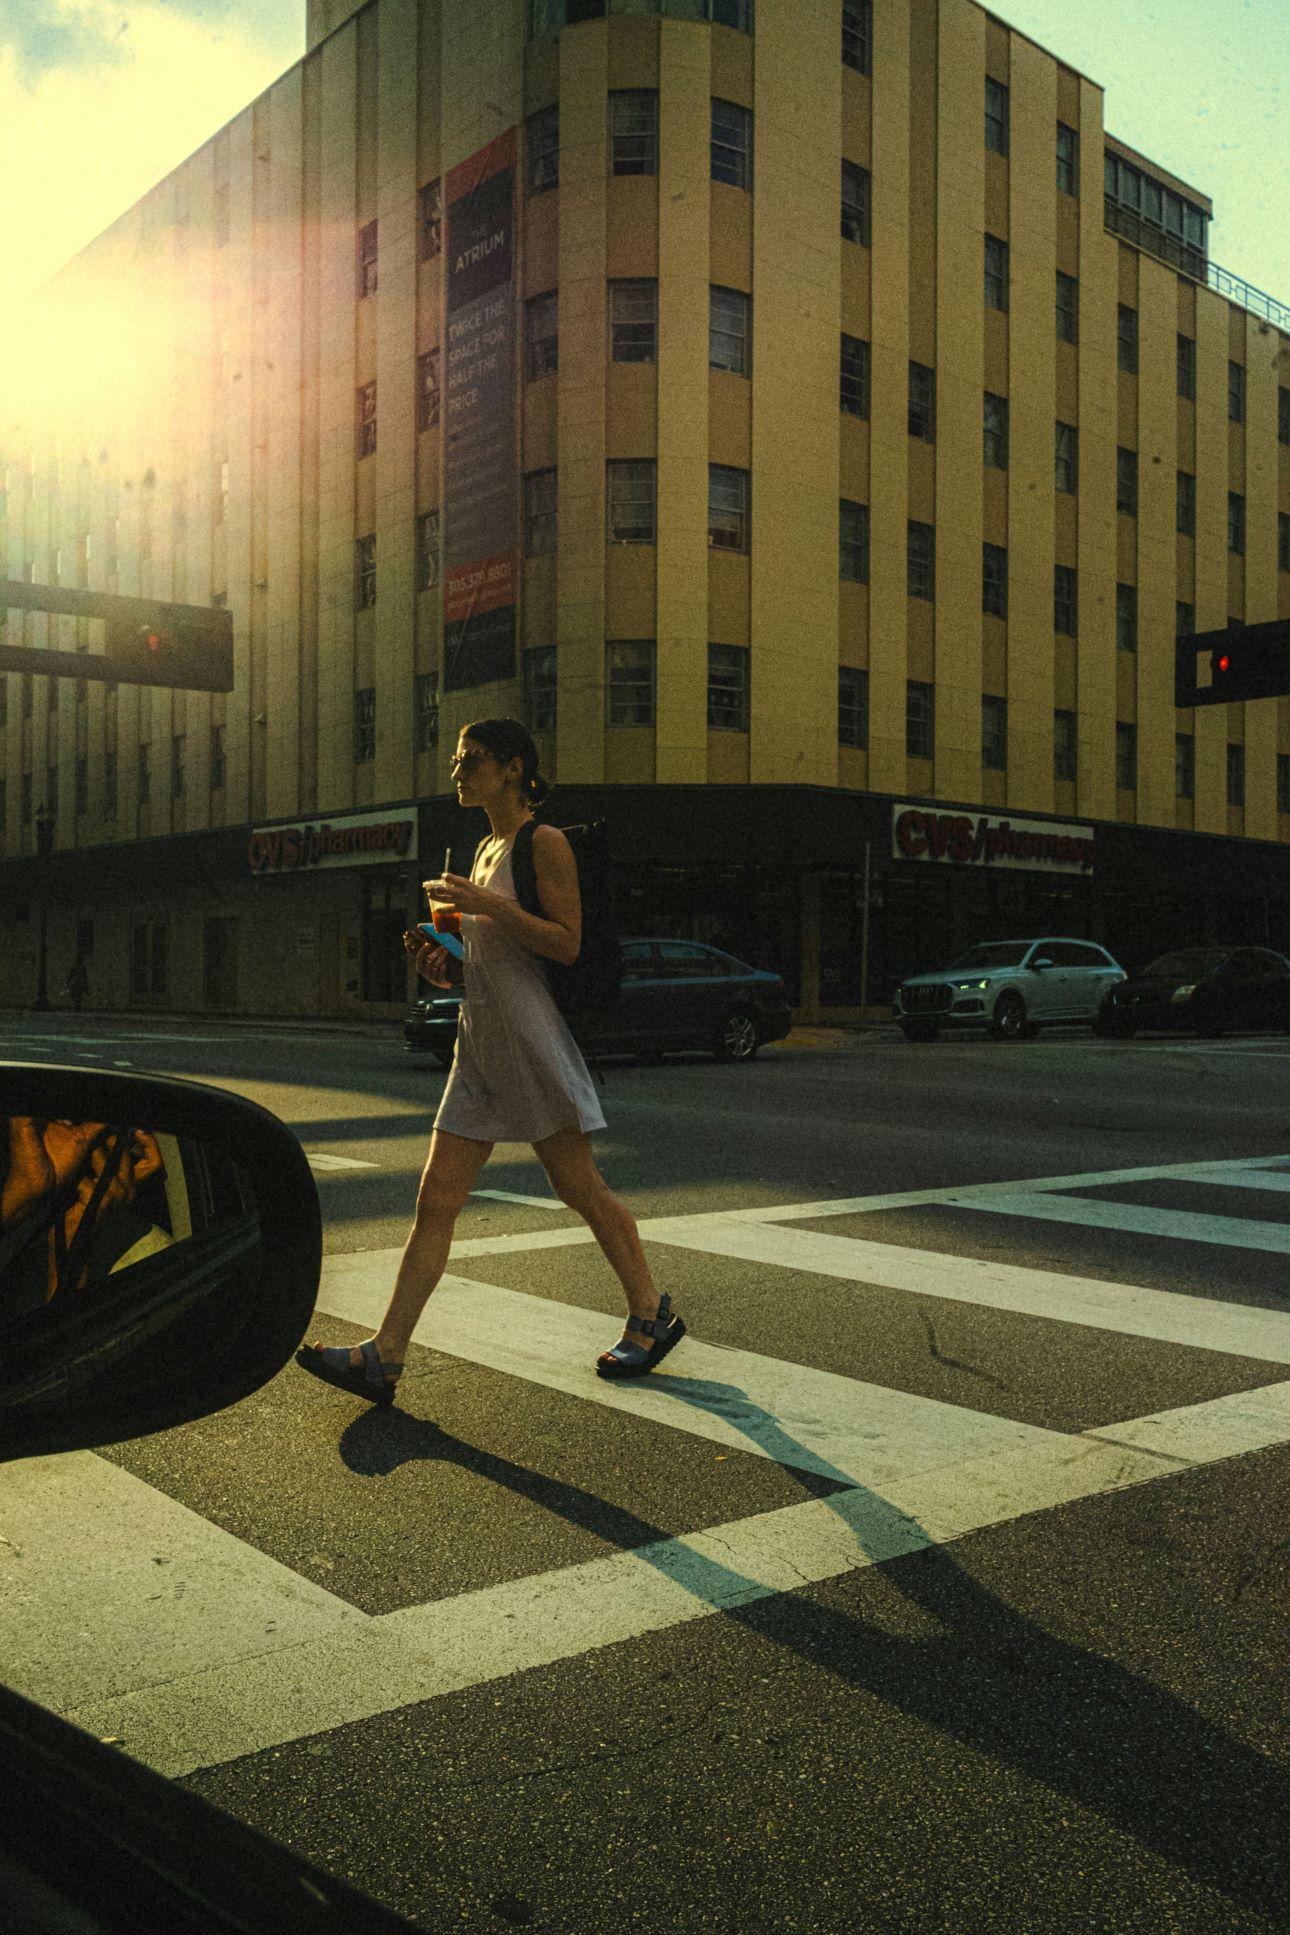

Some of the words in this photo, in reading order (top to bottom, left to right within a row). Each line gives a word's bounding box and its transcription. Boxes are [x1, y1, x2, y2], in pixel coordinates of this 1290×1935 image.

[455, 229, 505, 274] ATRIUM
[448, 313, 481, 341] TWICE
[484, 302, 505, 321] THE
